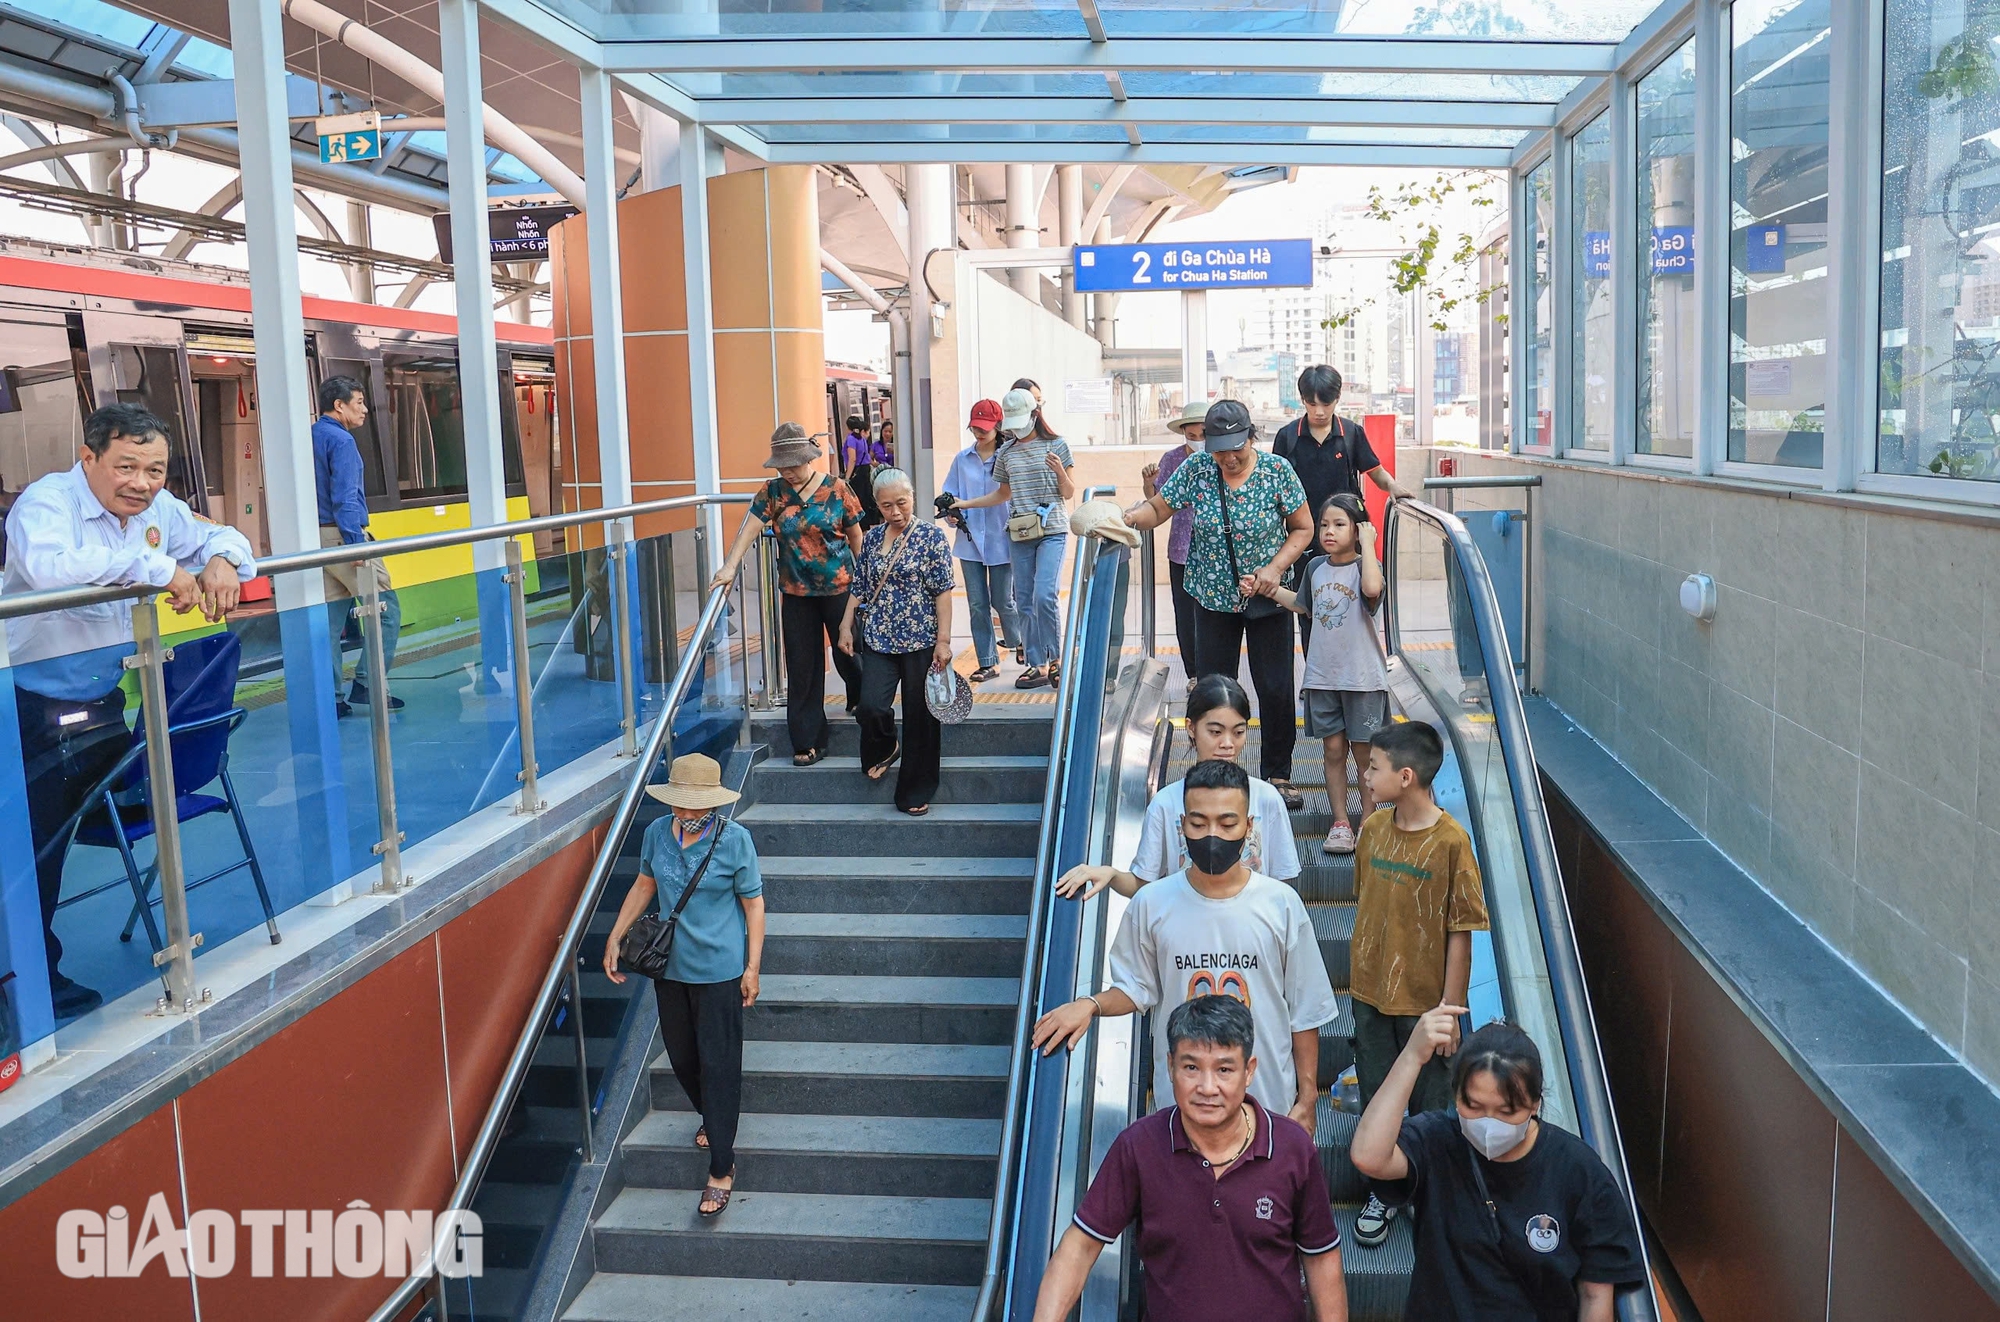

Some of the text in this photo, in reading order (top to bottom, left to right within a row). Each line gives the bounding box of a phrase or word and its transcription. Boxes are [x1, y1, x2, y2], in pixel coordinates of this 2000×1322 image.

[495, 241, 520, 252] hành
[529, 240, 536, 250] 6
[538, 239, 548, 252] ph
[1163, 248, 1271, 267] đi Ga Chùa Hà
[1132, 251, 1152, 284] 2
[1163, 269, 1268, 282] for Chua Ha Station
[1174, 953, 1259, 970] BALENCIAGA
